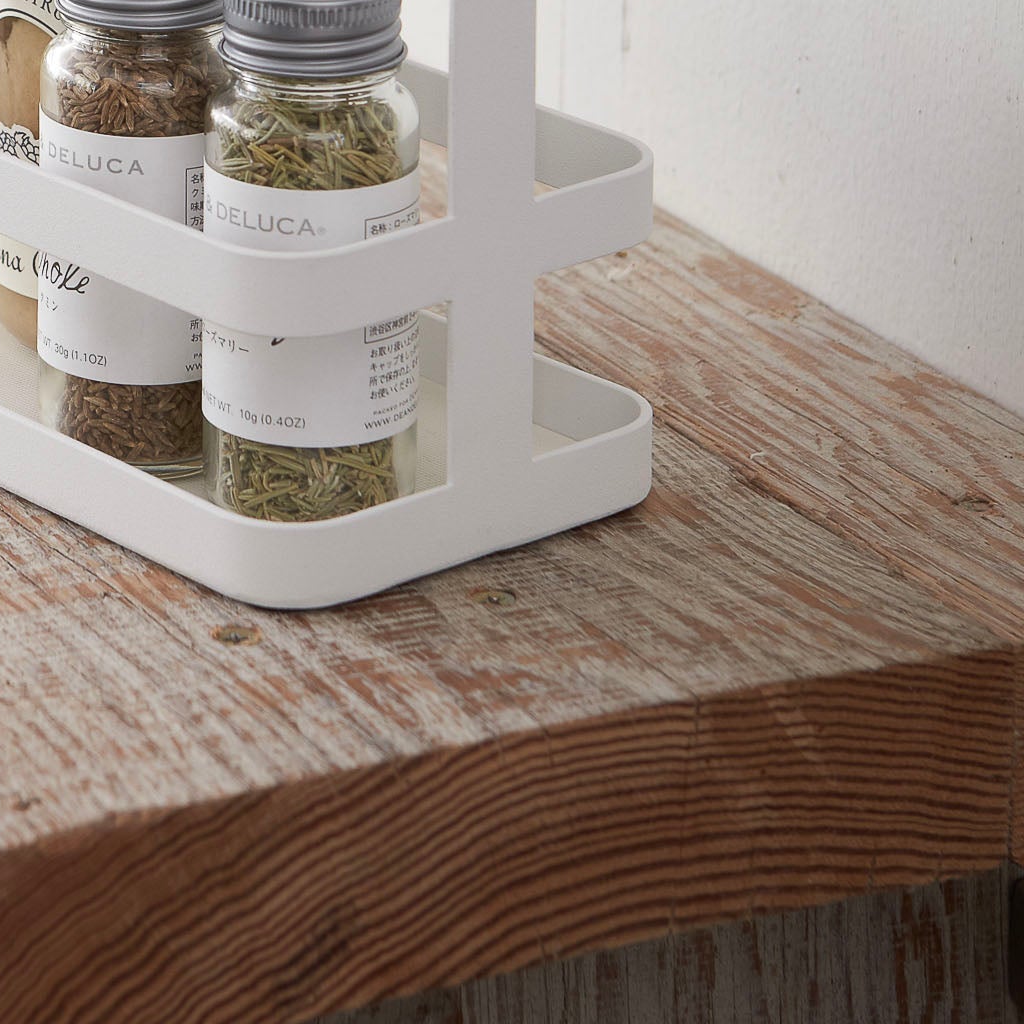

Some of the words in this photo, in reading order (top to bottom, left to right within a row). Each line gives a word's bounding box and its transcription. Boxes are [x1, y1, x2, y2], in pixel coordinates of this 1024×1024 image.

[48, 141, 145, 176] DELUCA
[54, 342, 69, 360] 30g
[71, 350, 107, 367] (1.1OZ)
[240, 407, 258, 425] 10g
[260, 413, 306, 429] (0.4OZ)
